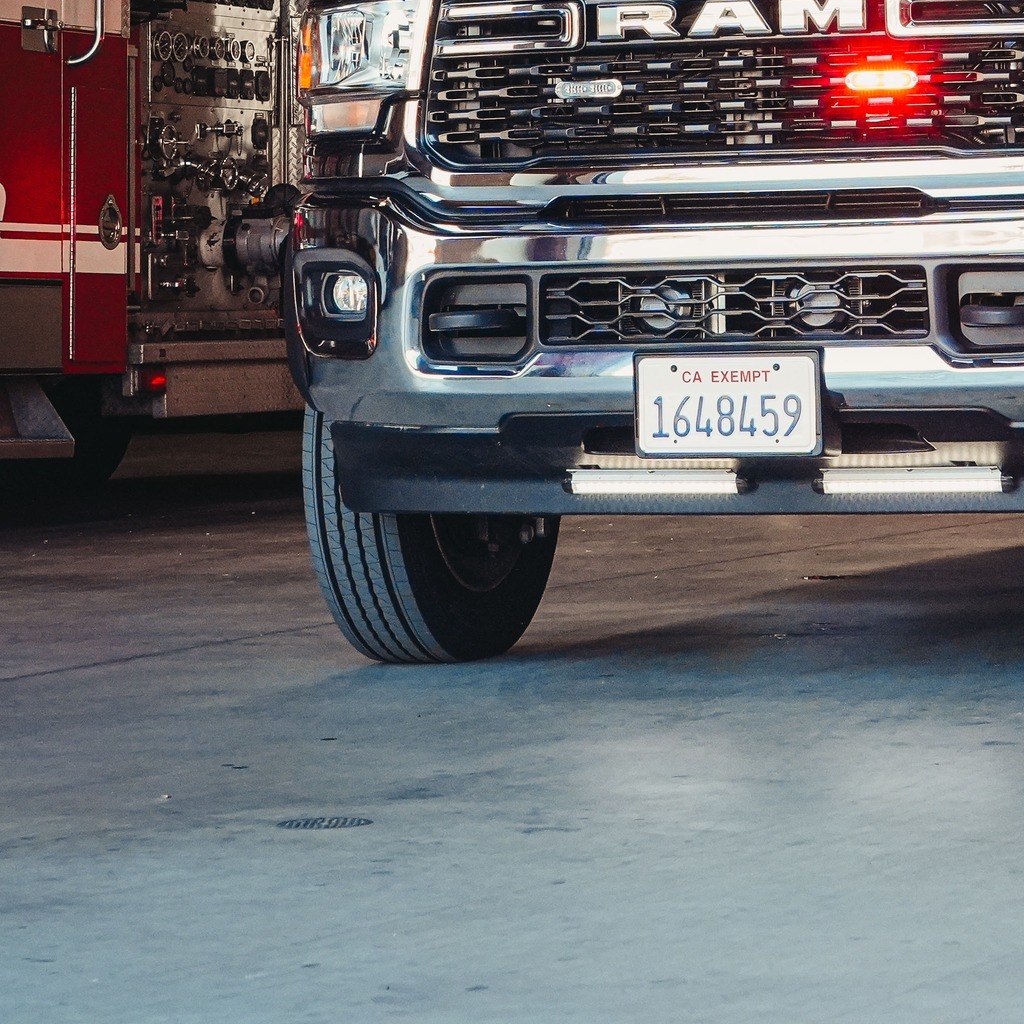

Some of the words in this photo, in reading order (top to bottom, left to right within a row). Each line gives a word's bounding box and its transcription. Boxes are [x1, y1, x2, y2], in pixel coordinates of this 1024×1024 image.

[681, 370, 702, 383] CA
[710, 370, 771, 383] EXEMPT
[652, 393, 802, 438] 1648459
